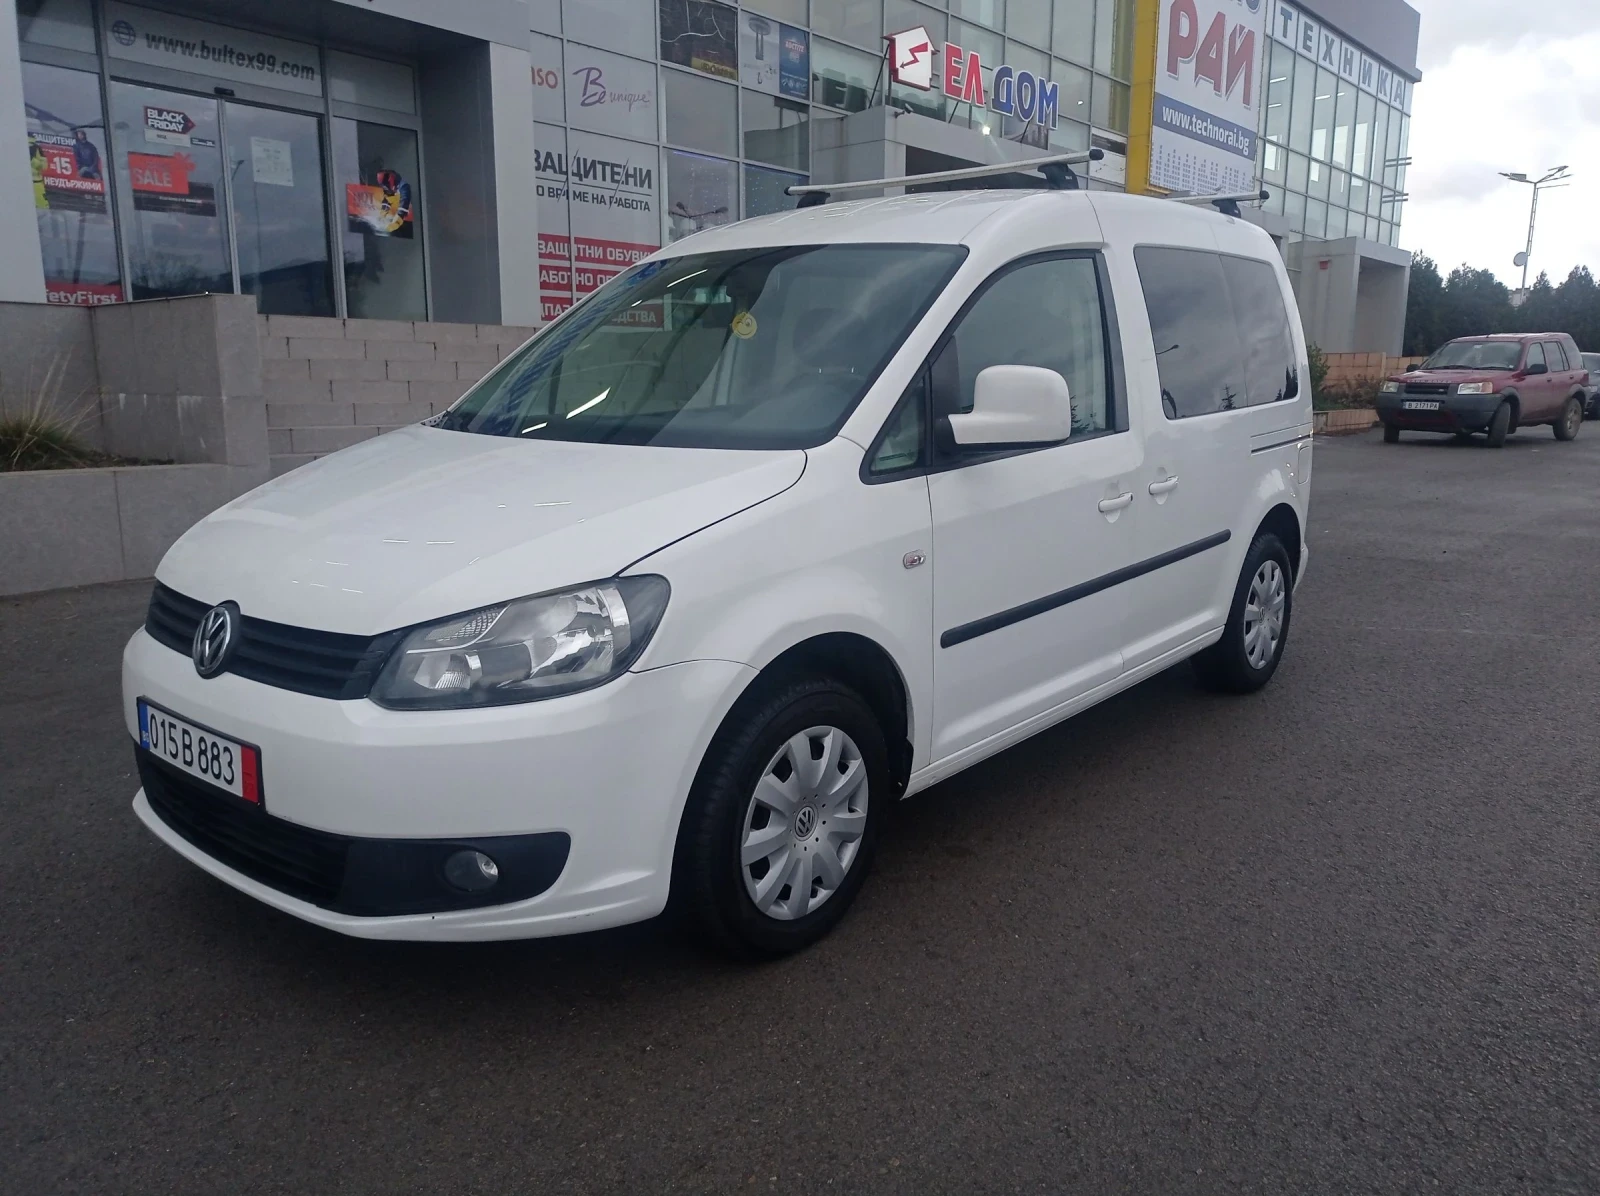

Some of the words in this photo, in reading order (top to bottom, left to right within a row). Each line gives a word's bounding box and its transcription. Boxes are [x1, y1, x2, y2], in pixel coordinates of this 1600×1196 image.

[145, 32, 315, 81] www.bultex99.com
[1280, 6, 1403, 105] ТЕХНИКА
[147, 108, 185, 123] BLACK
[147, 118, 184, 132] FRIDAY
[1162, 105, 1250, 156] www.technorai.bg
[133, 167, 173, 187] SALE
[592, 193, 607, 206] НА
[609, 195, 651, 212] РАБОТА
[46, 289, 117, 305] etyFirst
